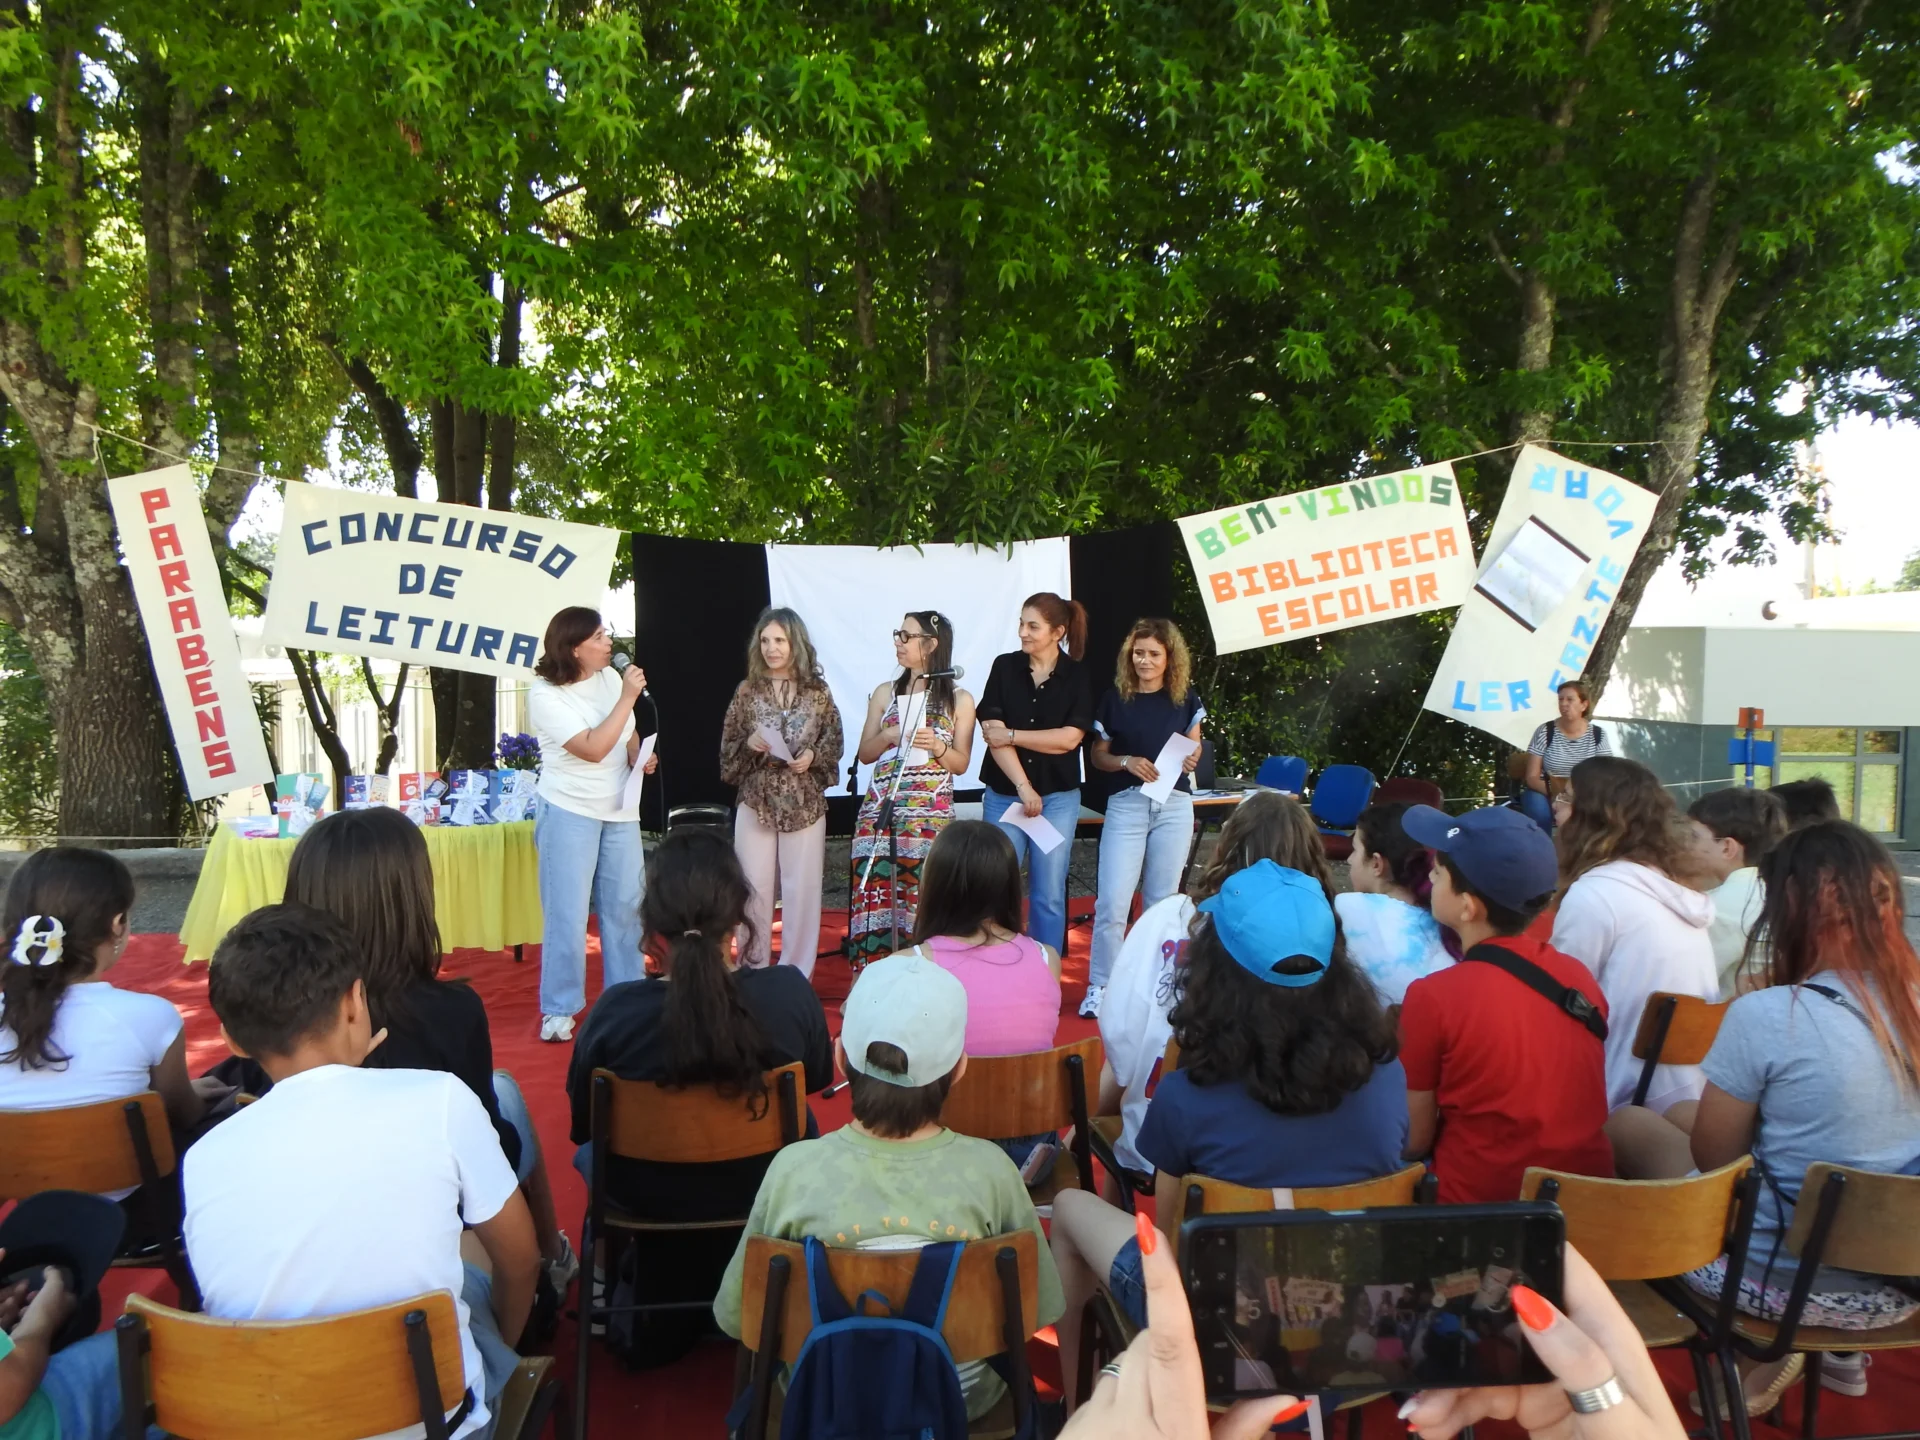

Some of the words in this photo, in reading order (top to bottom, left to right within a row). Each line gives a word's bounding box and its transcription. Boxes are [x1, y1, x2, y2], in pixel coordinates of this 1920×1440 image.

[1194, 474, 1453, 560] BEM-VINDOS
[1529, 463, 1634, 539] VOAR
[301, 512, 577, 579] CONCURSO
[1208, 527, 1459, 603] BIBLIOTECA
[399, 563, 463, 600] DE
[1257, 572, 1440, 637] ESCOLAR
[140, 487, 237, 779] PARABÉNS
[305, 601, 539, 668] LEITURA
[1452, 679, 1532, 712] LER
[824, 1223, 861, 1248] ST
[882, 1215, 909, 1228] TO
